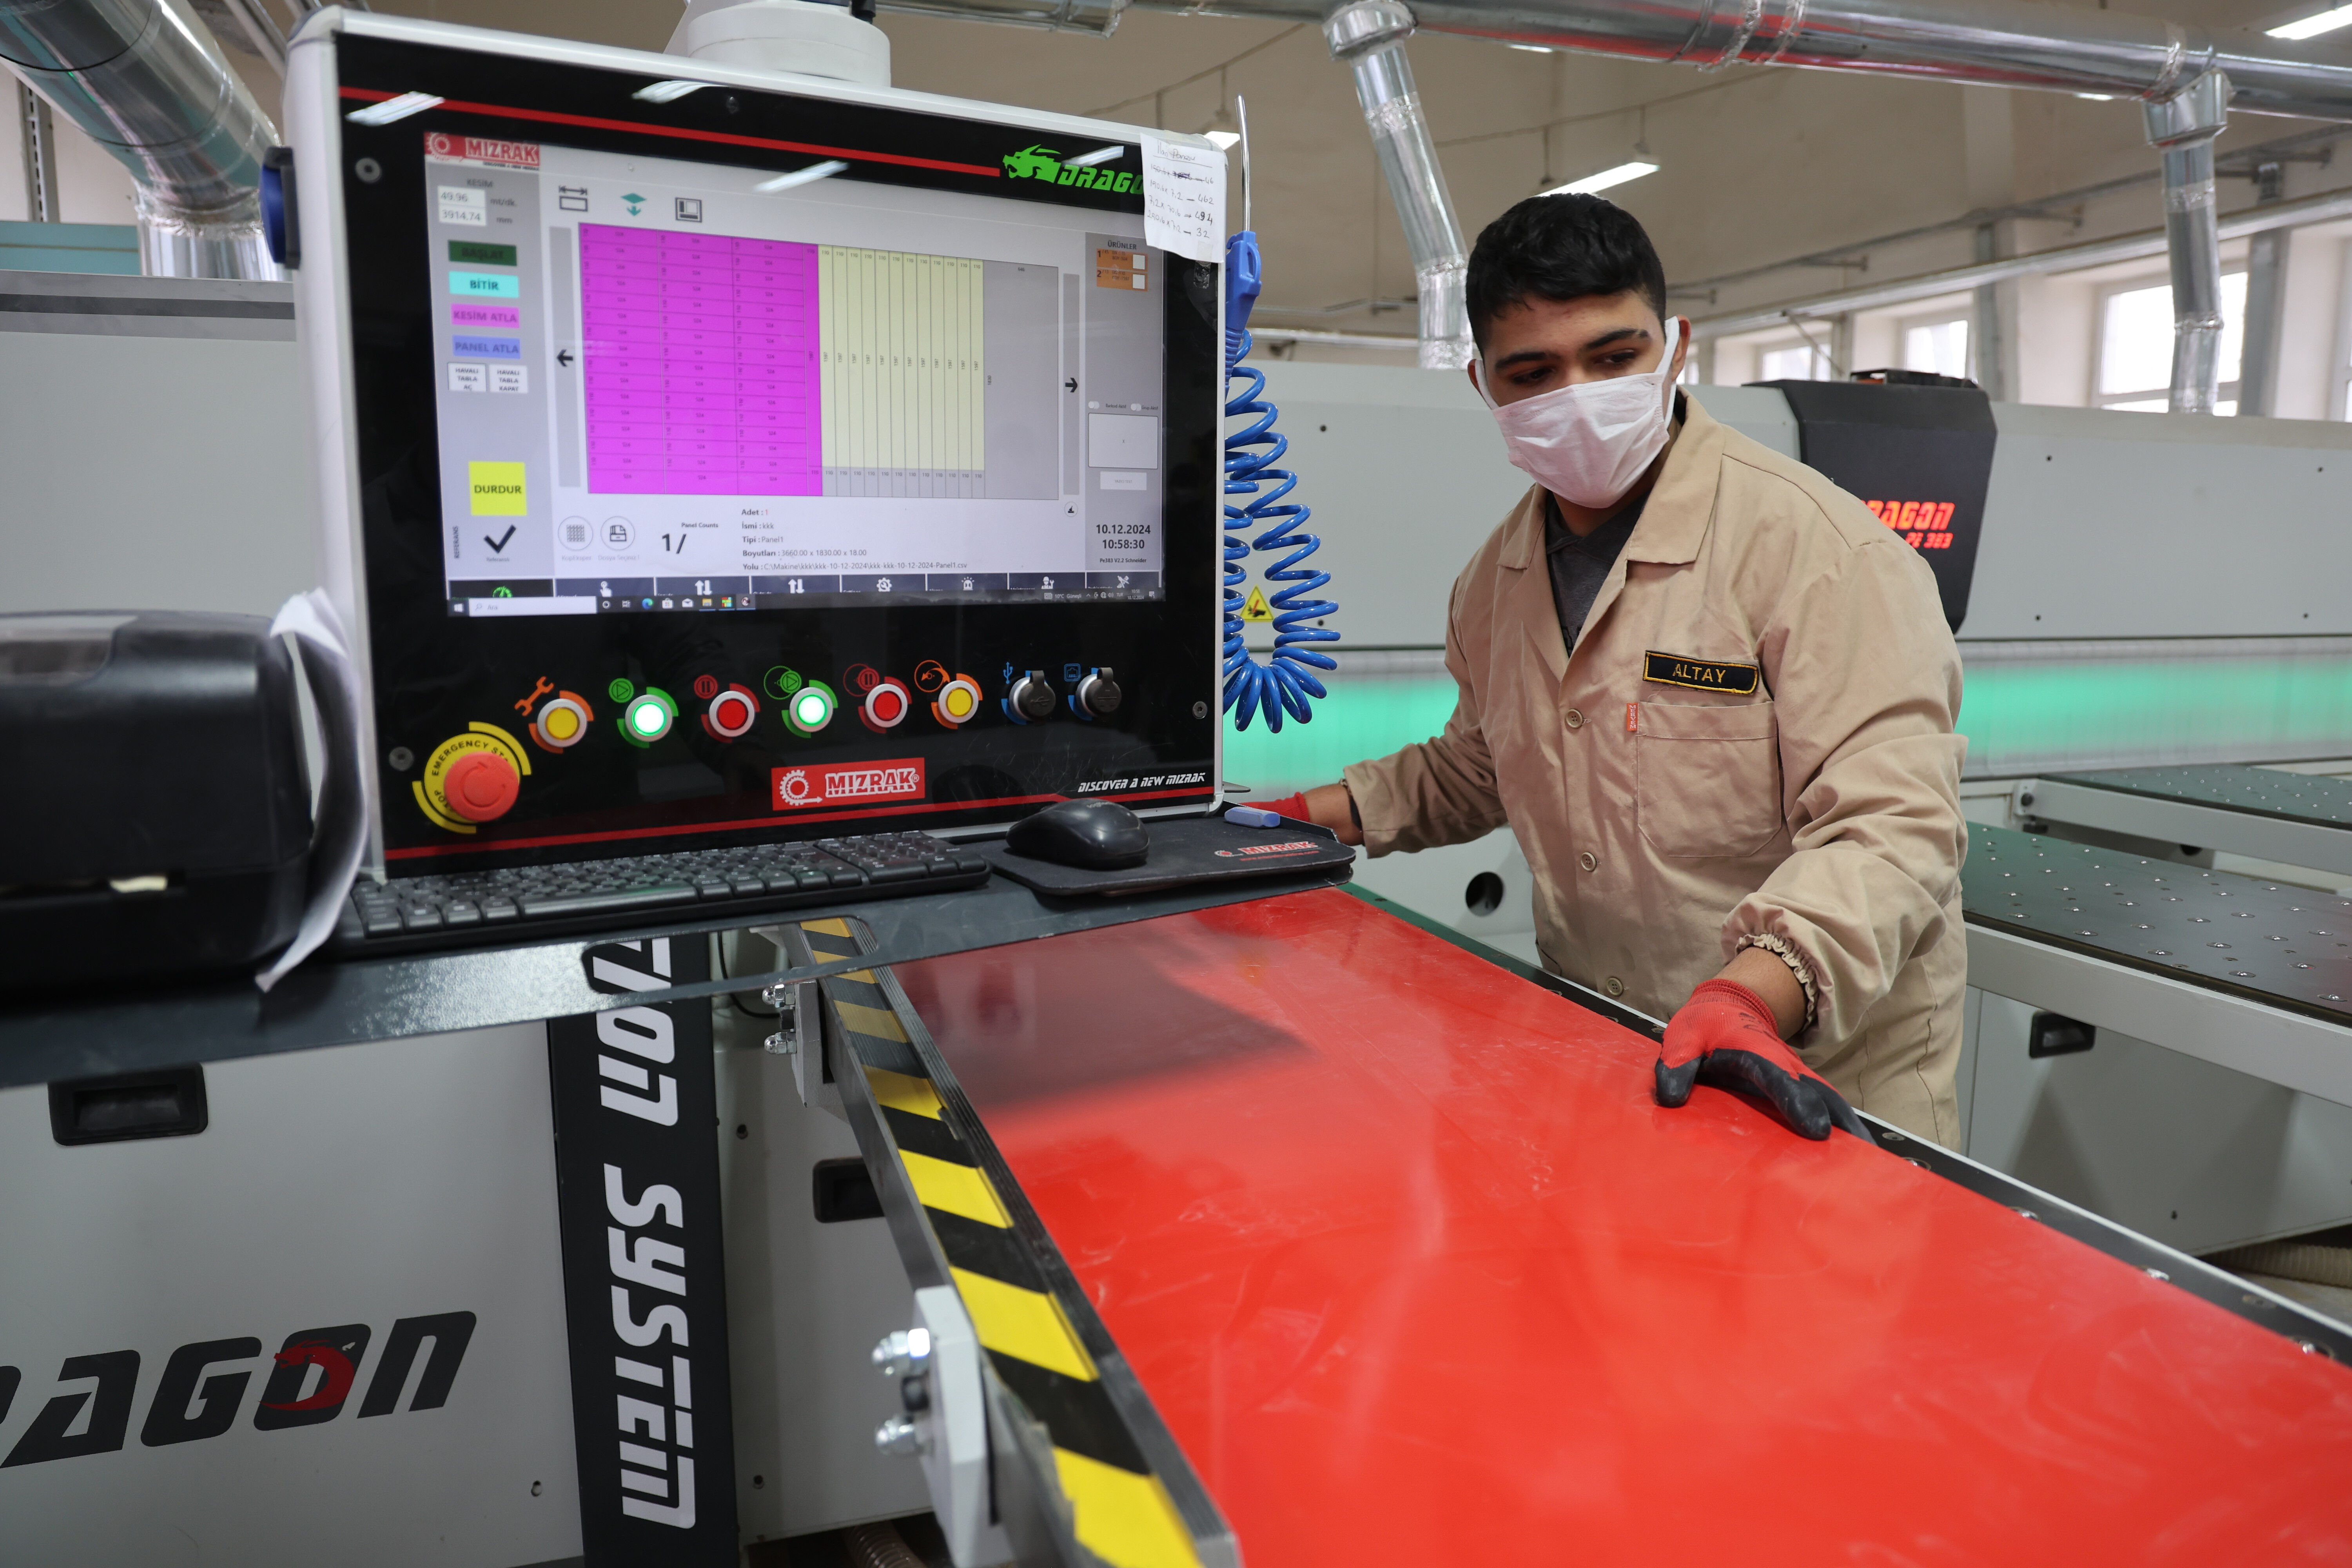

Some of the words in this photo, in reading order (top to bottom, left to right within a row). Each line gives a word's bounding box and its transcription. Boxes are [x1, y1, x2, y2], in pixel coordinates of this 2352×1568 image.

[466, 138, 539, 163] MIZRAK
[1057, 164, 1144, 194] DRAGO
[1198, 194, 1214, 205] 462
[442, 209, 481, 221] 3914.74
[1197, 228, 1210, 238] 32
[1108, 240, 1137, 250] ÜRÜNLER
[470, 278, 499, 290] BİTİR
[491, 313, 517, 323] ATLA
[455, 342, 489, 352] PANEL
[492, 344, 519, 353] ATLA
[474, 485, 522, 494] DURDUR
[1861, 500, 1956, 531] RAGON
[1096, 524, 1151, 534] 10.12.2024
[1102, 539, 1145, 549] 10:58:30
[743, 550, 776, 558] Boyutları
[1672, 664, 1726, 684] ALTAY
[432, 740, 489, 777] EMERGENCY
[1078, 778, 1129, 793] DISCOVER
[1129, 778, 1139, 788] A
[1140, 776, 1165, 787] NEW
[1165, 773, 1206, 785] MIZRAK
[1238, 841, 1318, 855] MIZRAK
[603, 1163, 695, 1530] SYSTEM
[0, 1310, 477, 1469] AGON
